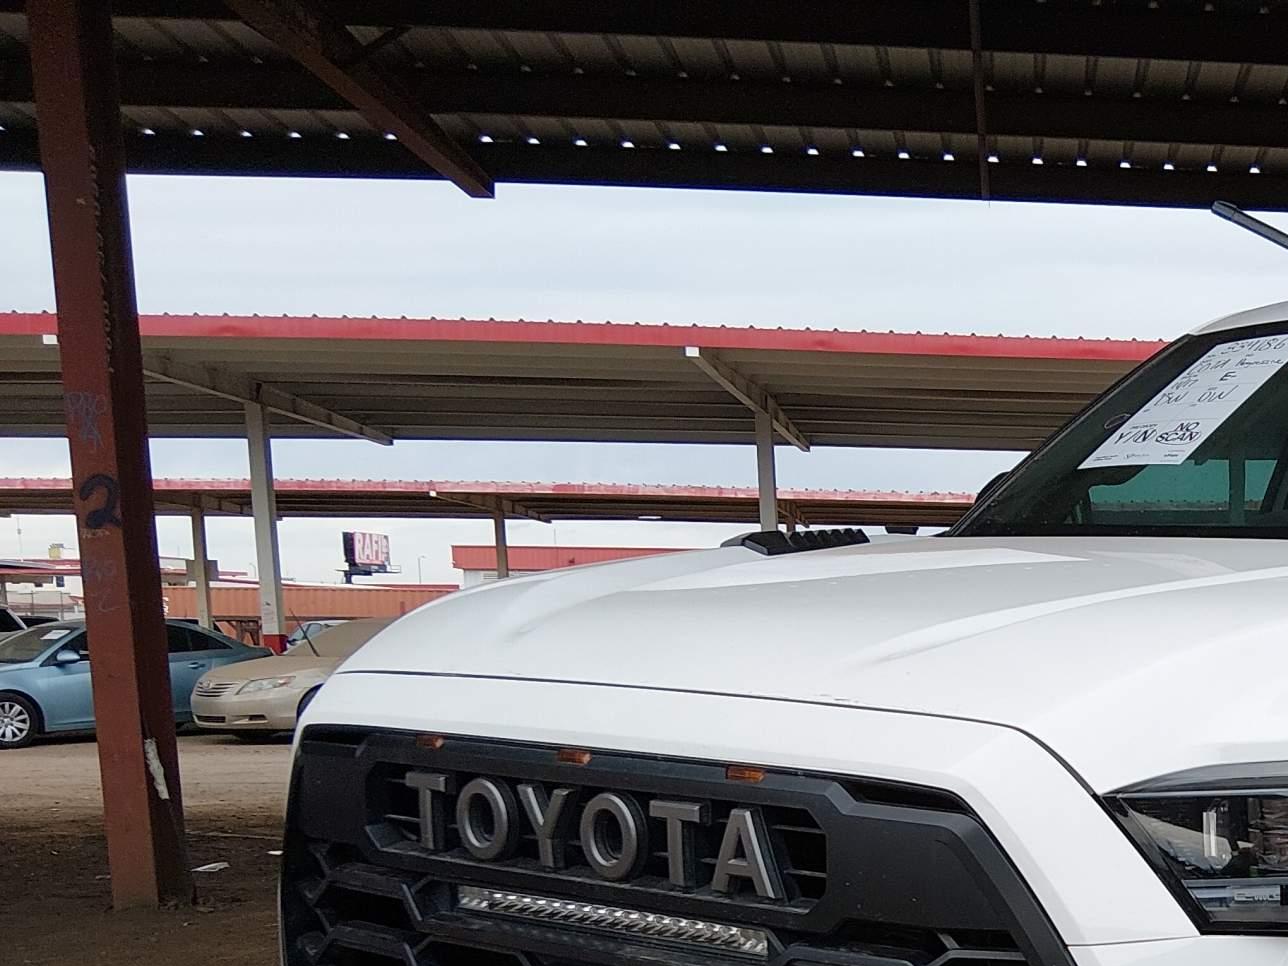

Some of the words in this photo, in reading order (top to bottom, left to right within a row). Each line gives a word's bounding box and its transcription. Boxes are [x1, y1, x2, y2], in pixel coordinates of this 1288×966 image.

[1155, 431, 1201, 443] SCAN
[79, 473, 122, 529] 2
[405, 770, 784, 900] TOYOTA
